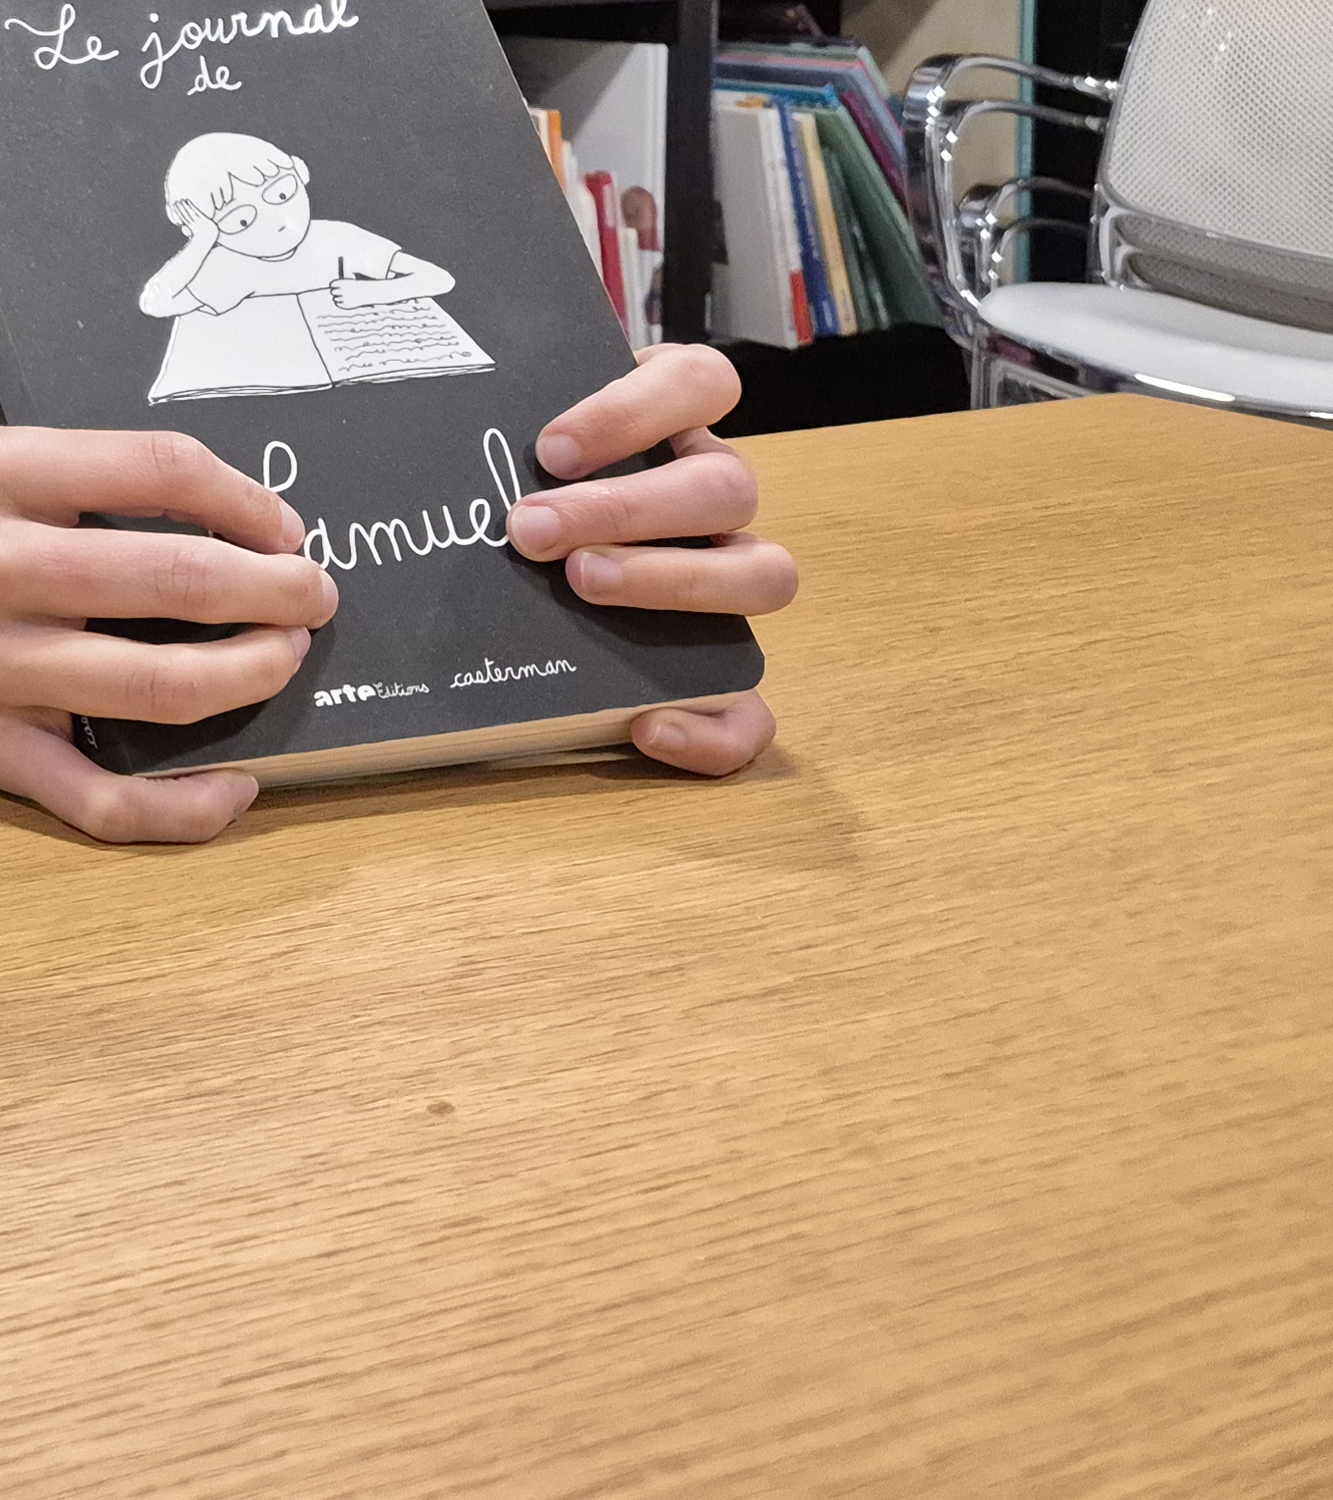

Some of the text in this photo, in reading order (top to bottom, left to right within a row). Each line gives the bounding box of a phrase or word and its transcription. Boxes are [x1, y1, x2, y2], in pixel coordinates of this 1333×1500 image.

[4, 2, 120, 71] Le
[187, 54, 244, 96] de
[449, 655, 578, 690] casterman
[313, 683, 376, 708] arte
